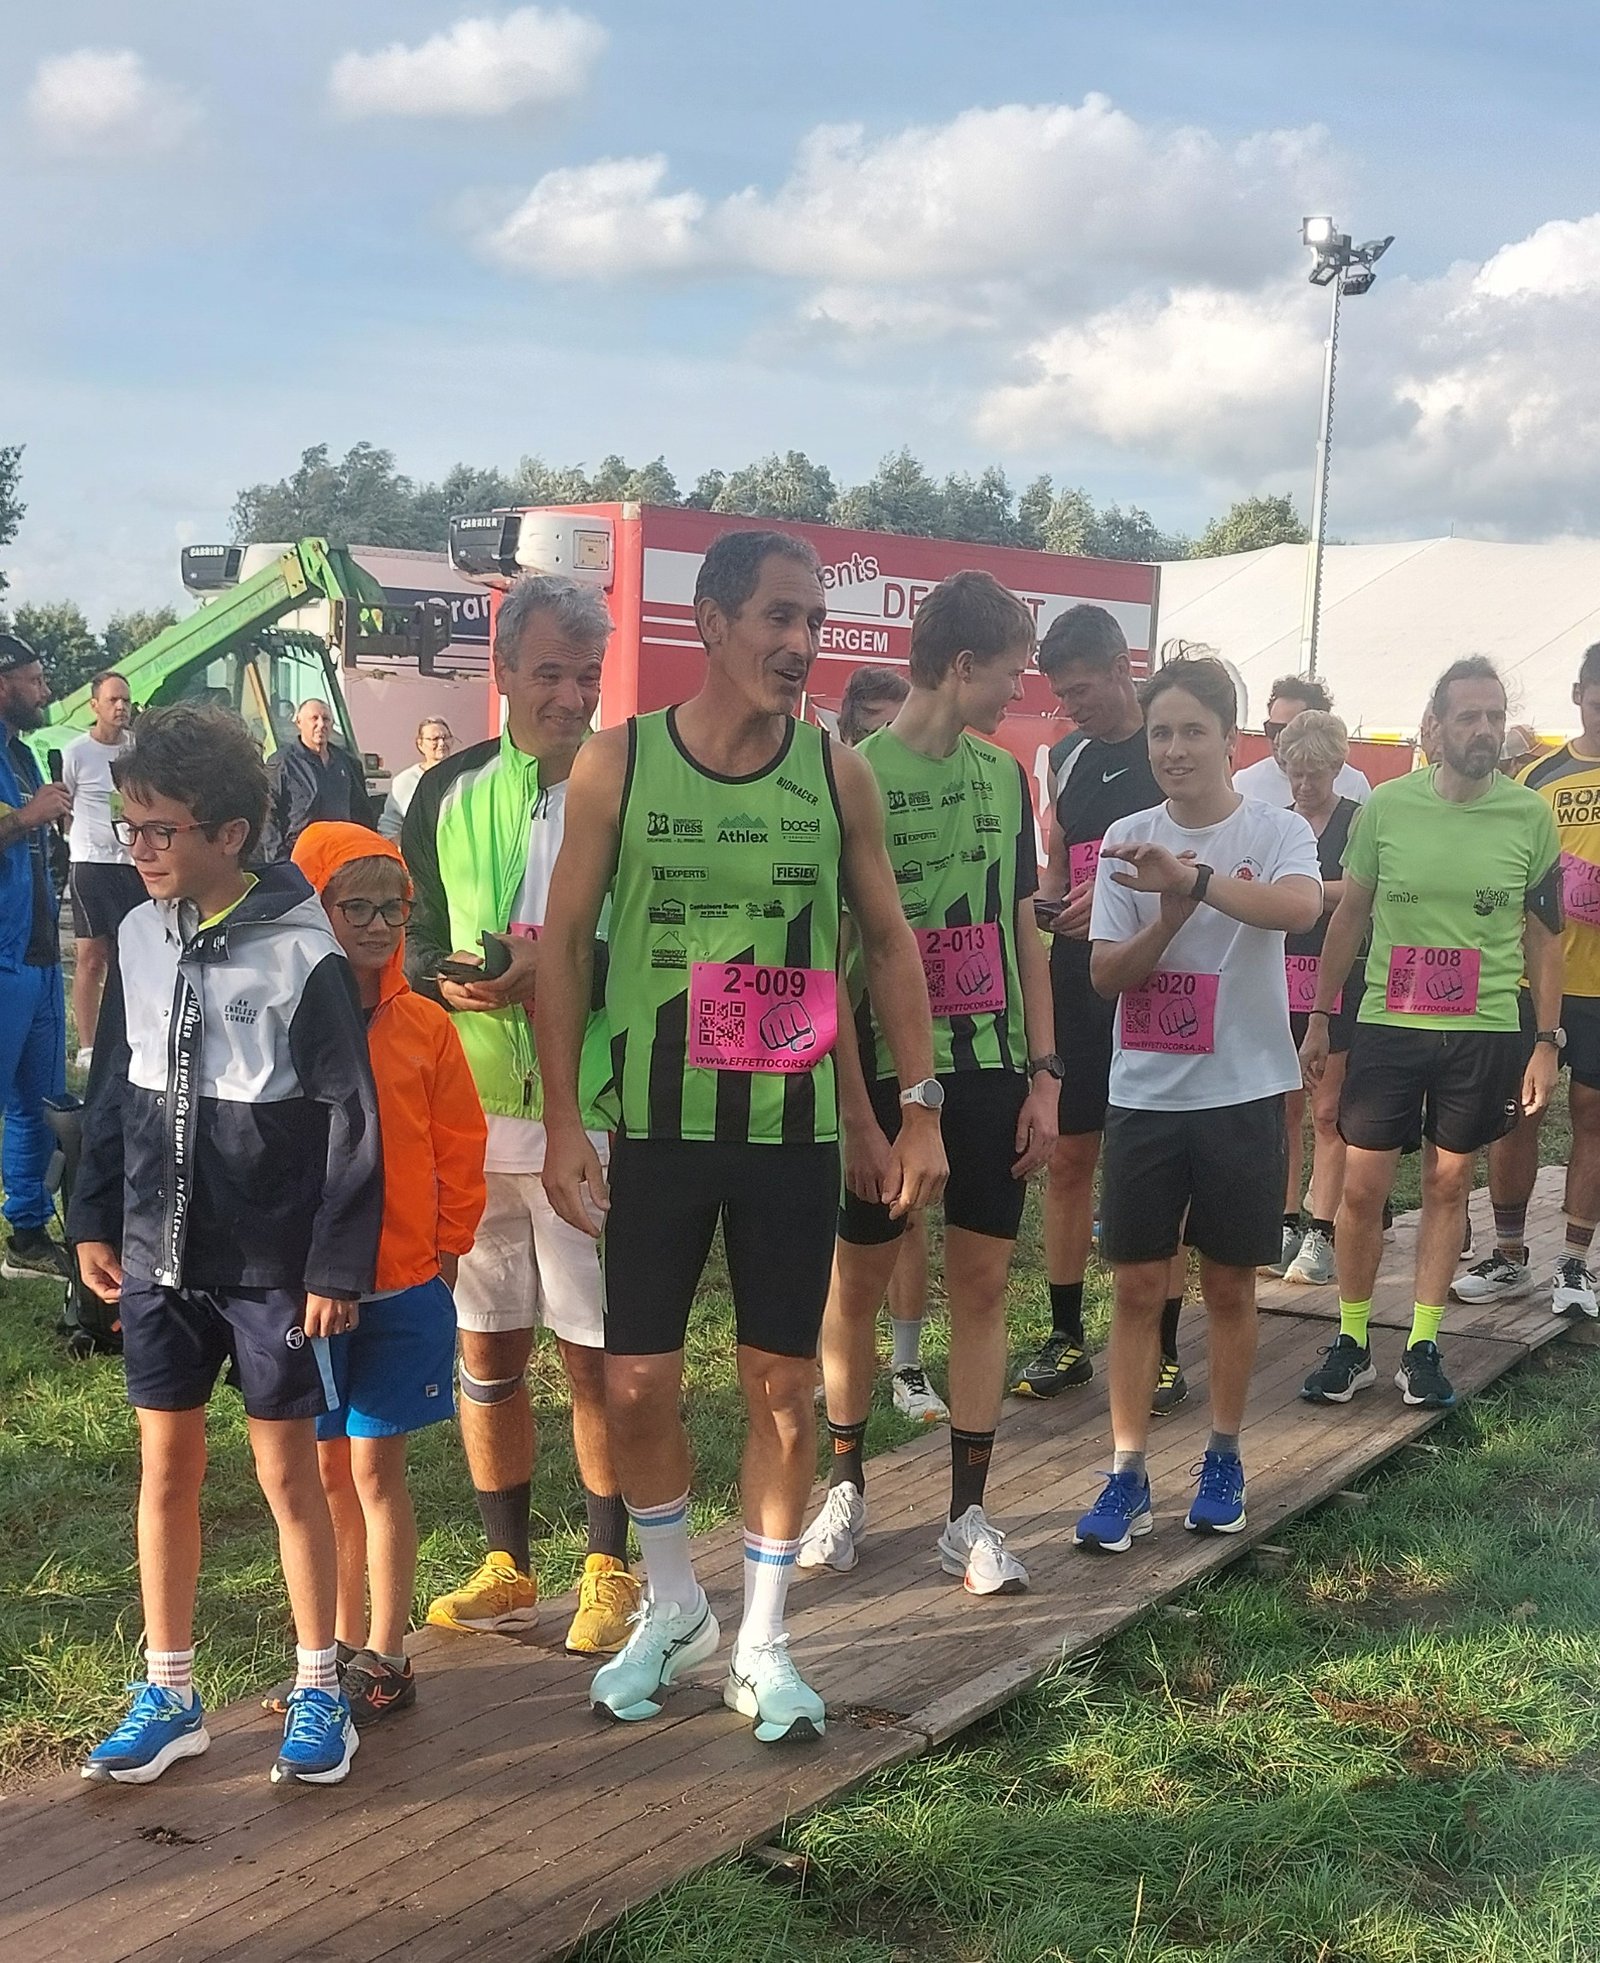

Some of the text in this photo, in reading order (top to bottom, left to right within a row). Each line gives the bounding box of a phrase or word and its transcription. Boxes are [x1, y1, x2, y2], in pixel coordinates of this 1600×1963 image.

[460, 517, 499, 529] CARRIER
[189, 546, 225, 557] CARRIER
[819, 626, 889, 653] ERGEM
[776, 776, 819, 806] BIORACER
[673, 823, 703, 835] press
[717, 830, 769, 843] Athlex
[666, 869, 707, 878] EXPERTS
[926, 927, 985, 954] 2-013
[1405, 948, 1462, 966] 2-008
[1285, 957, 1320, 972] 2-00
[723, 967, 807, 998] 2-009
[224, 1013, 256, 1025] SUMMER
